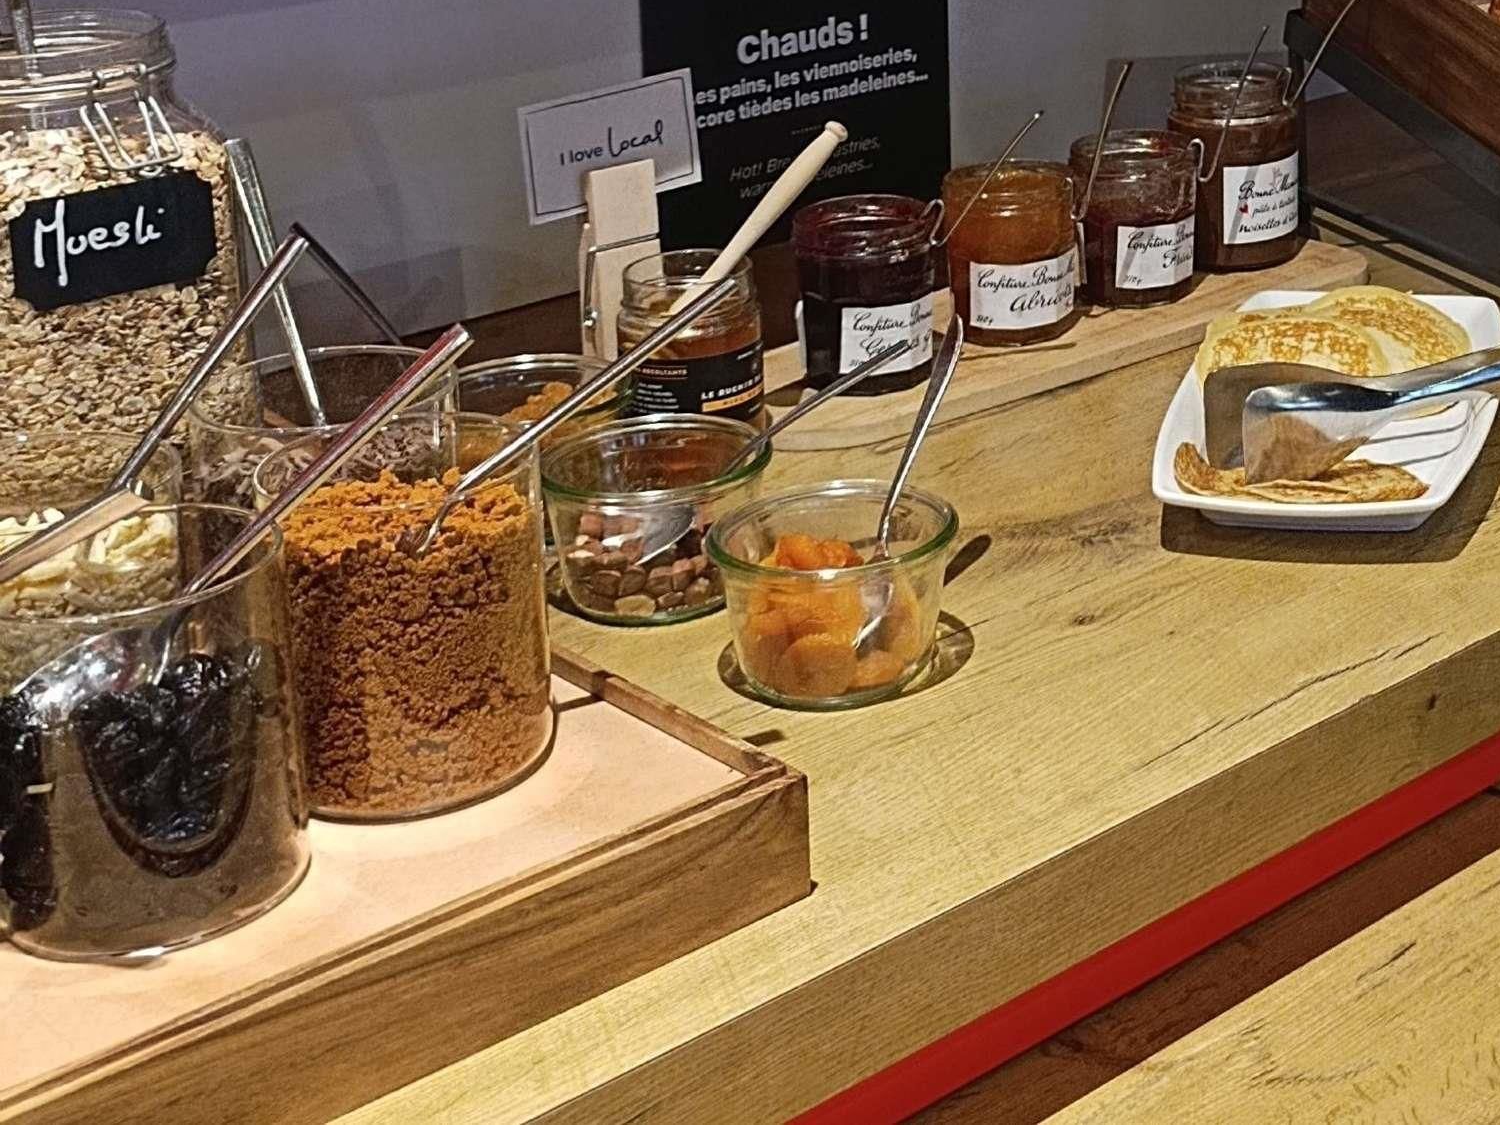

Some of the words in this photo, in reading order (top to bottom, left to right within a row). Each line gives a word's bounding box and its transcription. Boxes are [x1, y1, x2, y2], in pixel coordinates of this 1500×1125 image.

[736, 16, 854, 64] Chauds
[695, 88, 717, 106] es
[719, 77, 772, 104] pains,
[774, 70, 800, 89] les
[803, 47, 917, 82] viennoiseries,
[696, 108, 736, 129] core
[739, 96, 793, 120] tièdes
[795, 89, 821, 108] les
[570, 145, 603, 165] love
[34, 198, 165, 287] Muesli
[1127, 230, 1172, 254] Confiture
[977, 269, 1028, 293] Confiture
[853, 312, 904, 337] Confiture
[700, 391, 714, 400] LE
